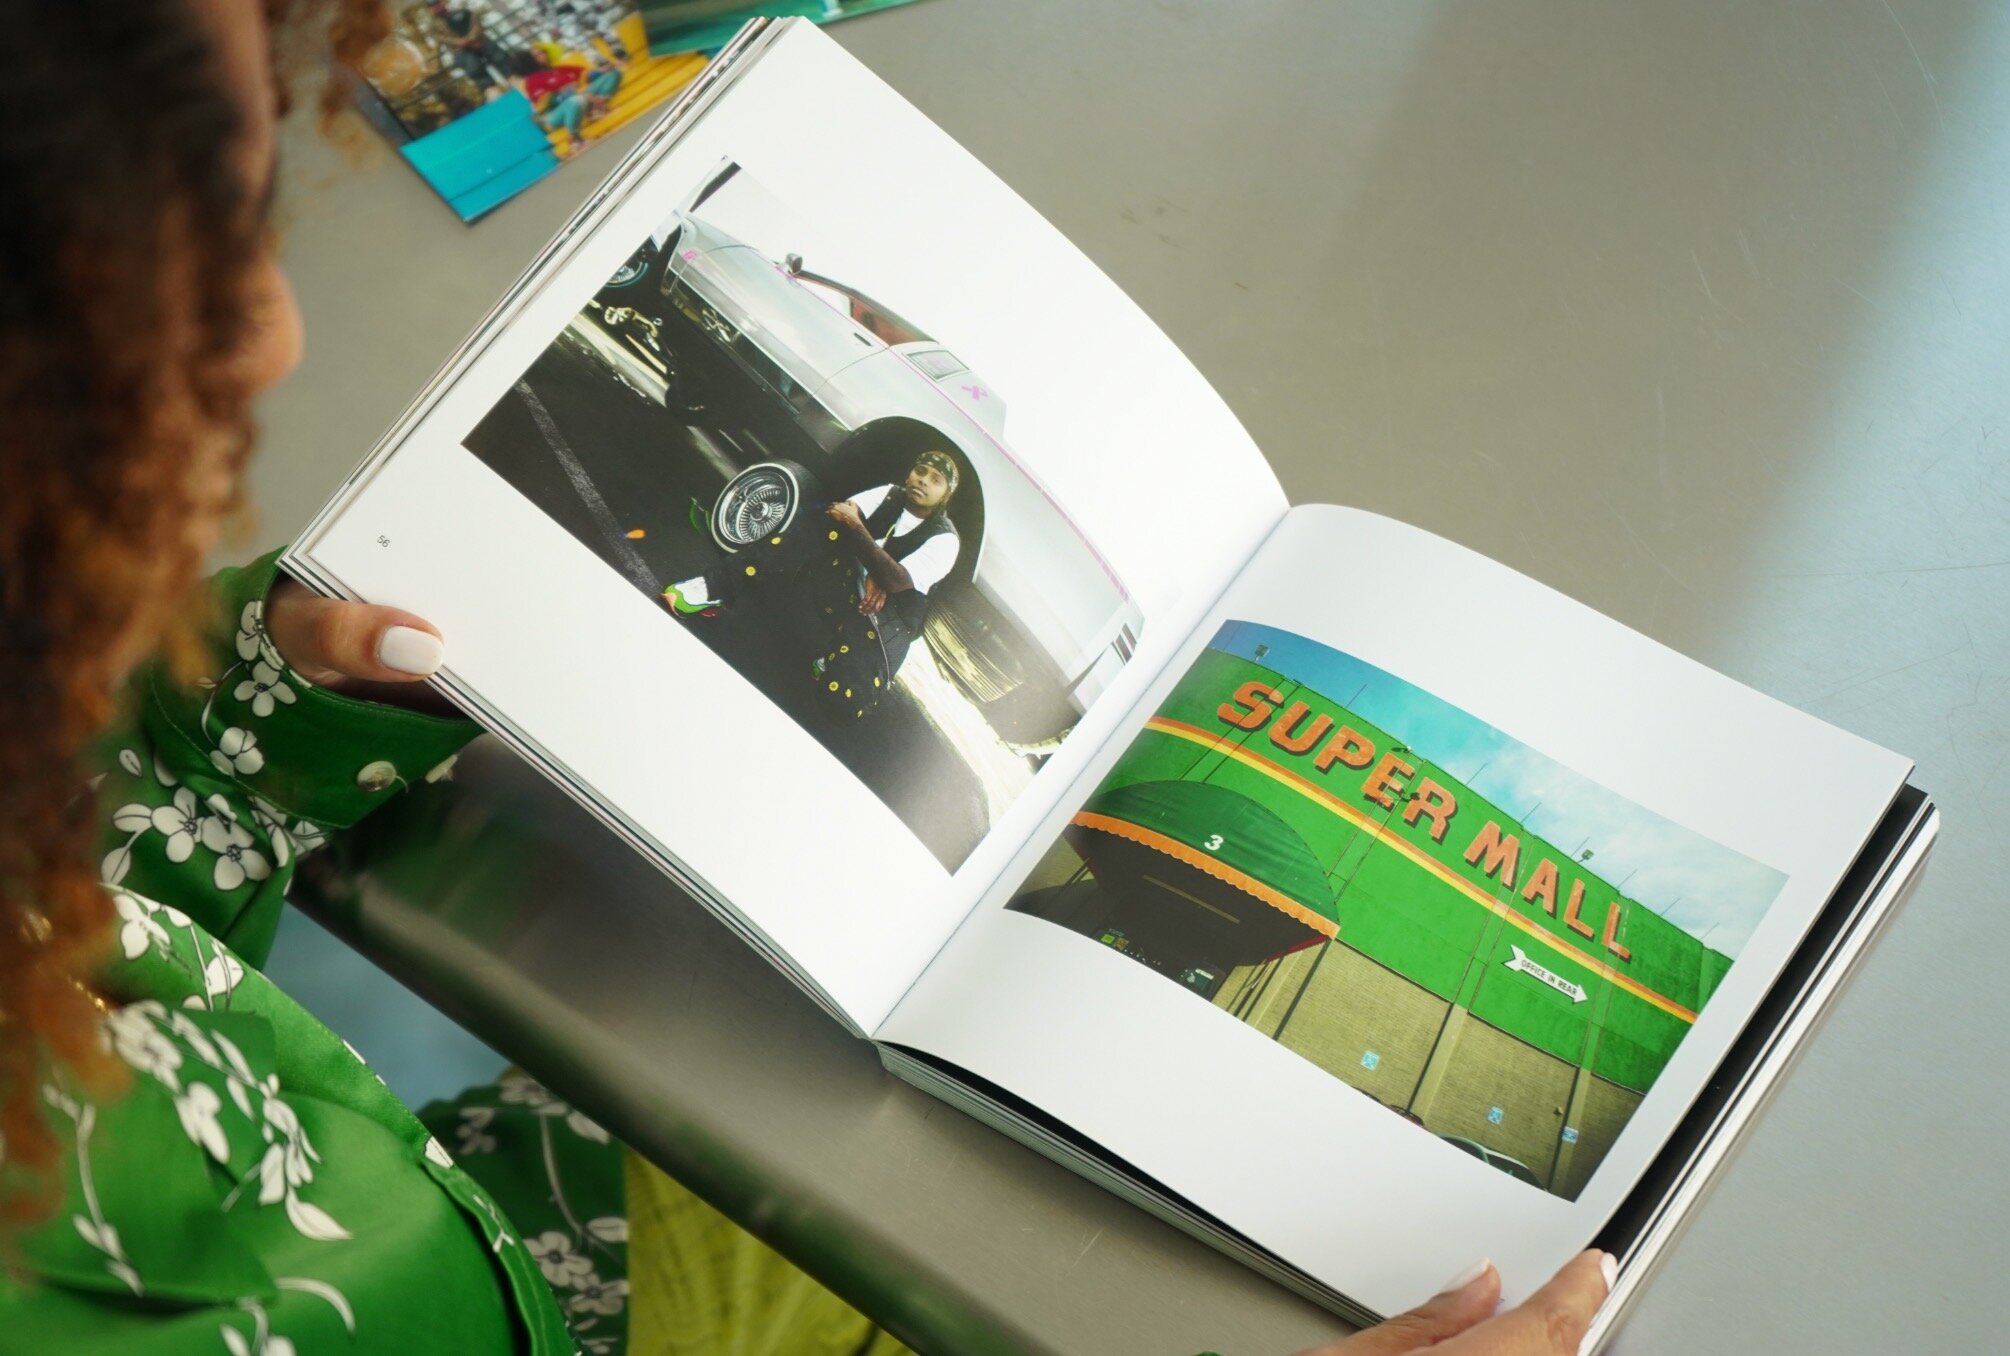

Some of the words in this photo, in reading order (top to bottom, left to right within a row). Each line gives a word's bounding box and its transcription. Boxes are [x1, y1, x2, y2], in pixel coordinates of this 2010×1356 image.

[377, 535, 390, 547] 56
[1217, 681, 1458, 844] SUPER
[1463, 820, 1631, 962] MALL
[1204, 834, 1224, 851] 3
[1521, 959, 1547, 979] OFFICE
[1548, 974, 1556, 984] IN
[1557, 981, 1578, 995] REAR
